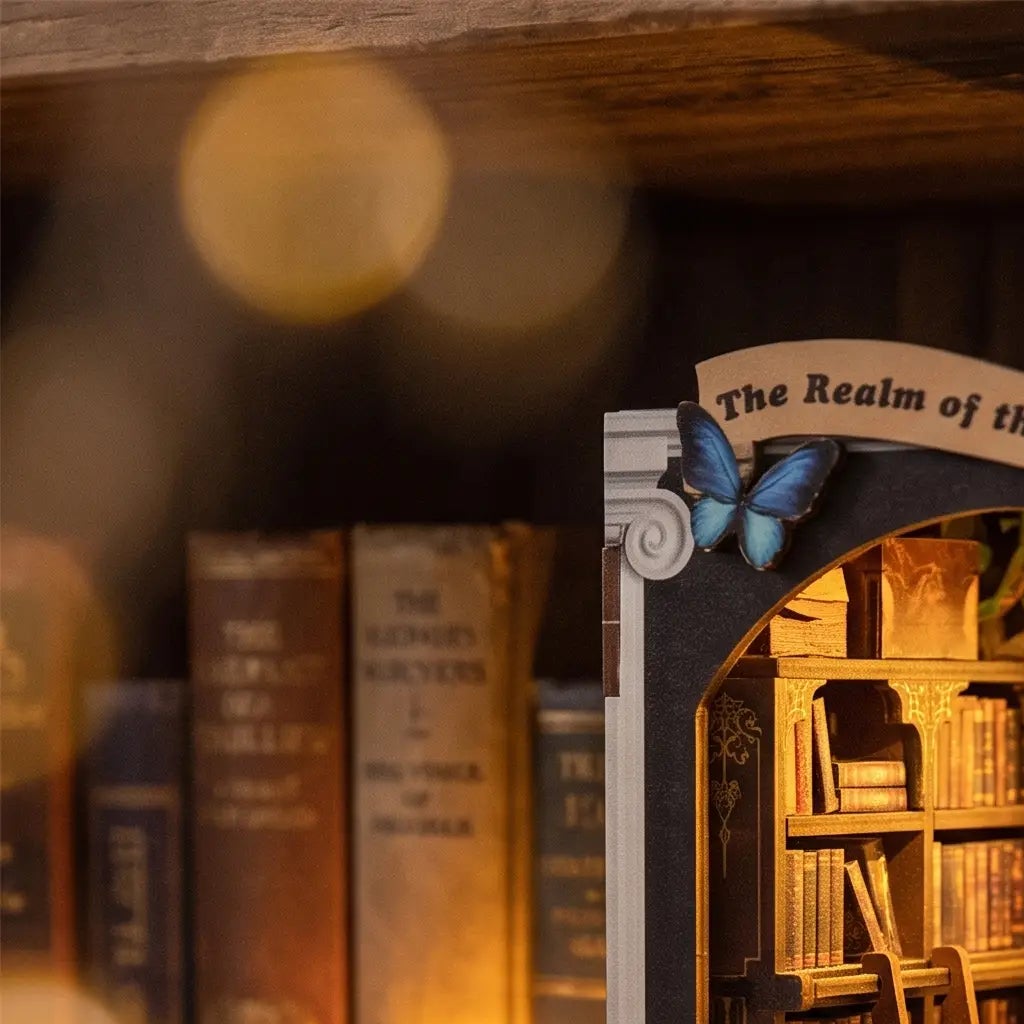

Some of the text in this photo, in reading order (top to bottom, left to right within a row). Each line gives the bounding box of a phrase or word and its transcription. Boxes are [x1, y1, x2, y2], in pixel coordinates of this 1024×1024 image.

[716, 383, 789, 421] The
[803, 373, 926, 411] Realm
[939, 393, 982, 429] of
